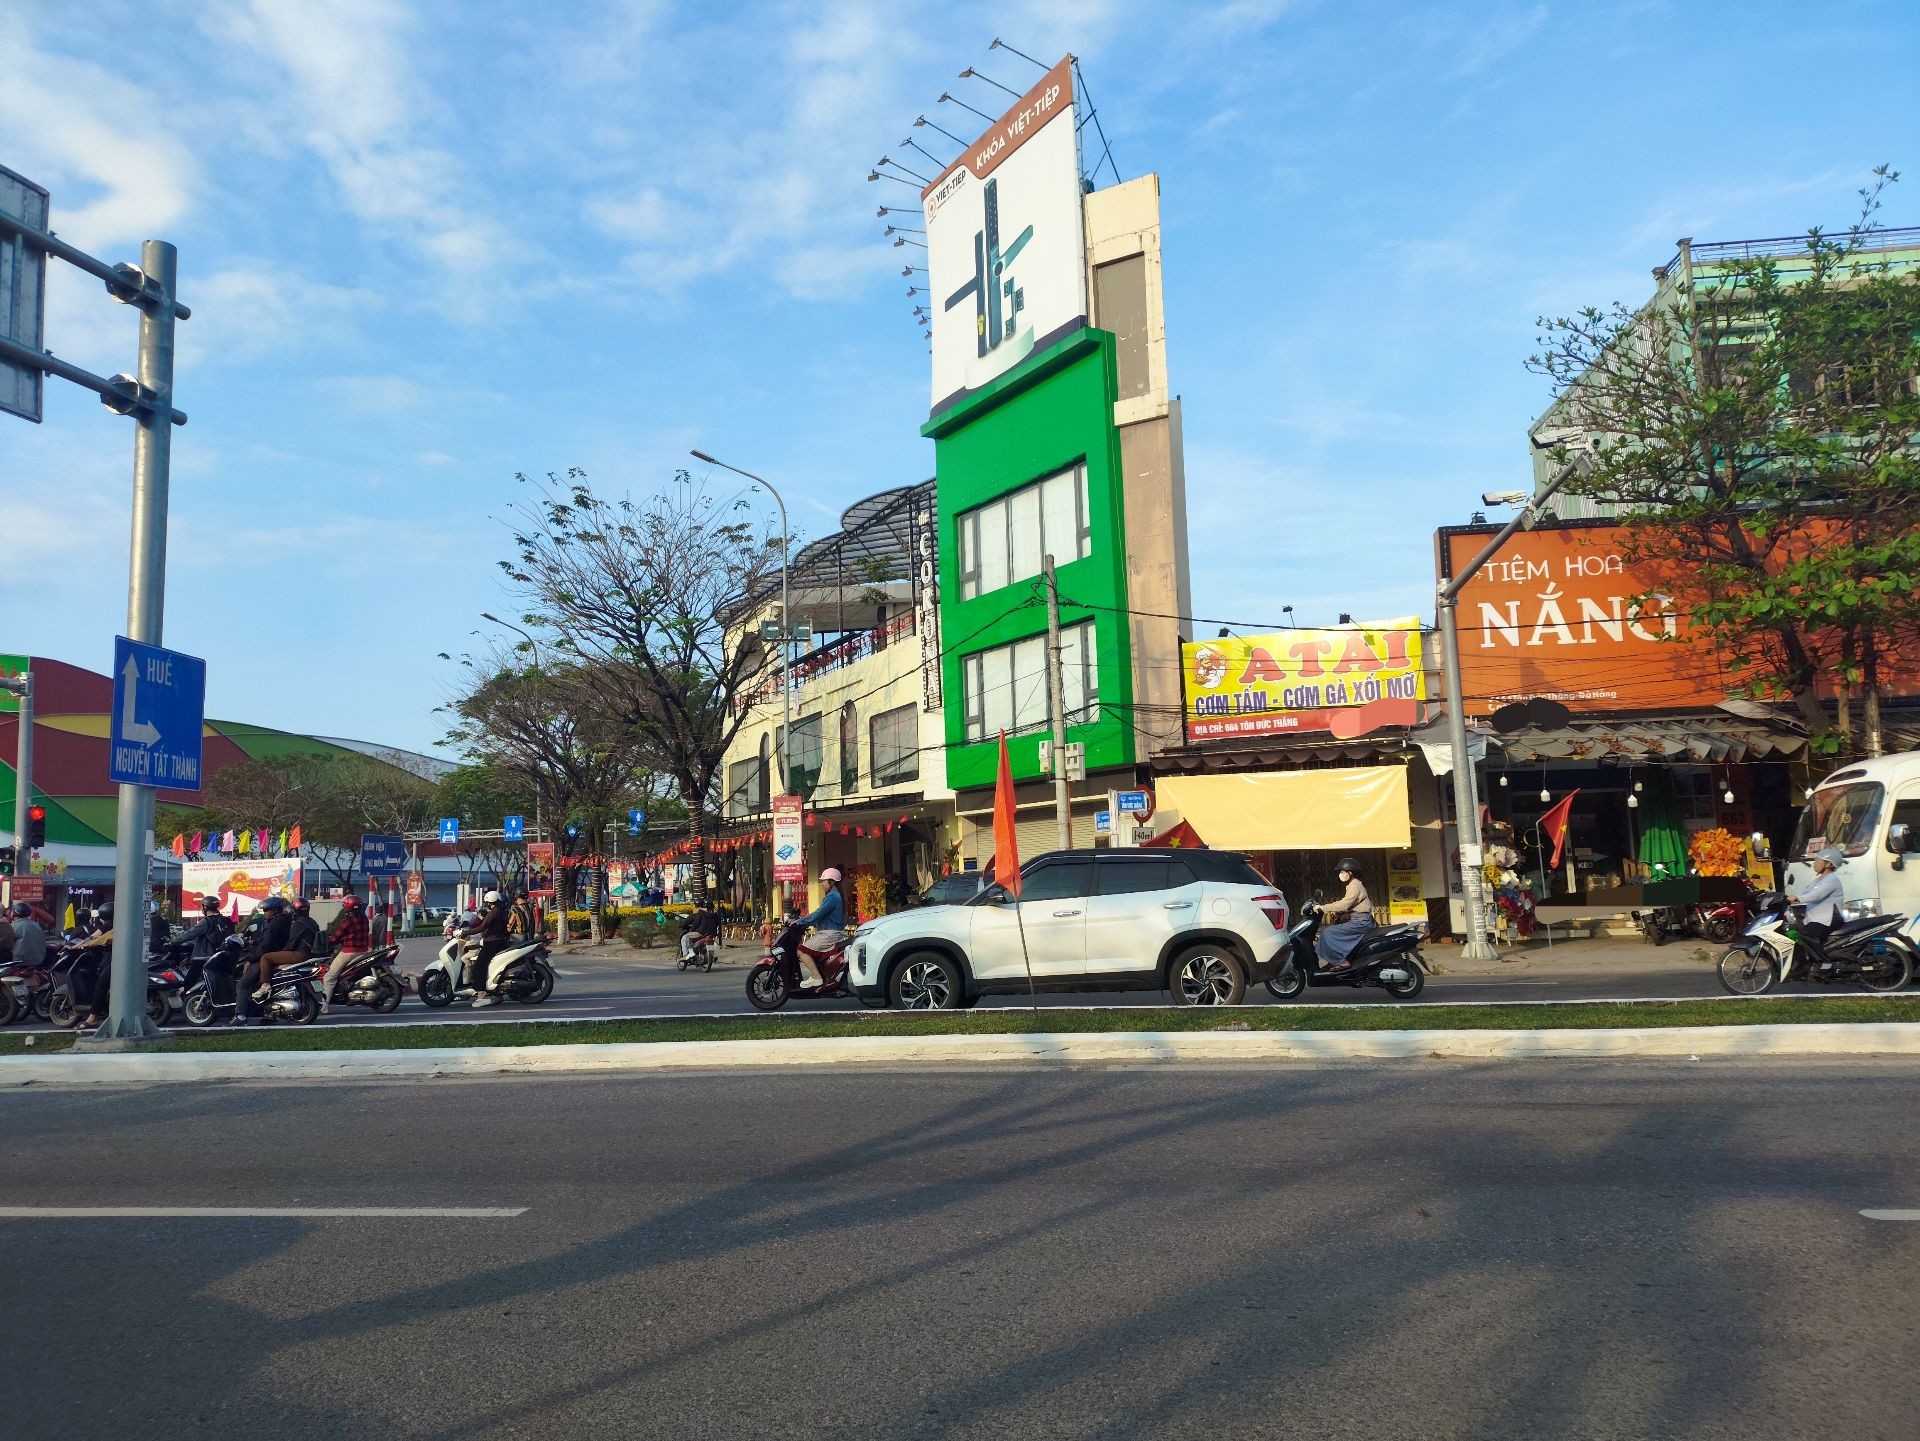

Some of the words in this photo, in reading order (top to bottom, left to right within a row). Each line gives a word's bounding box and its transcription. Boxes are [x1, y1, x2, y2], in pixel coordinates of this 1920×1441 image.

[976, 134, 1006, 170] KHÓA
[1007, 84, 1060, 139] VIỆT-TIỆP
[935, 169, 966, 203] VIET-TIEP
[1483, 553, 1549, 585] TIỆM
[1565, 554, 1623, 577] HOA
[919, 532, 939, 697] CORONA
[1477, 581, 1677, 649] NẮNG
[147, 654, 172, 686] HUẾ
[1195, 693, 1229, 717] CƠM
[1233, 684, 1267, 714] TẤM
[1283, 685, 1320, 708] CƠM
[1326, 678, 1348, 704] GÀ
[1353, 672, 1382, 702] XỐI
[1386, 671, 1415, 699] MỠ
[1240, 718, 1255, 731] TÔN
[1272, 714, 1298, 729] THẮNG
[115, 743, 151, 776] NGUYỄN
[153, 745, 169, 778] TẤT
[171, 751, 197, 782] THÀNH
